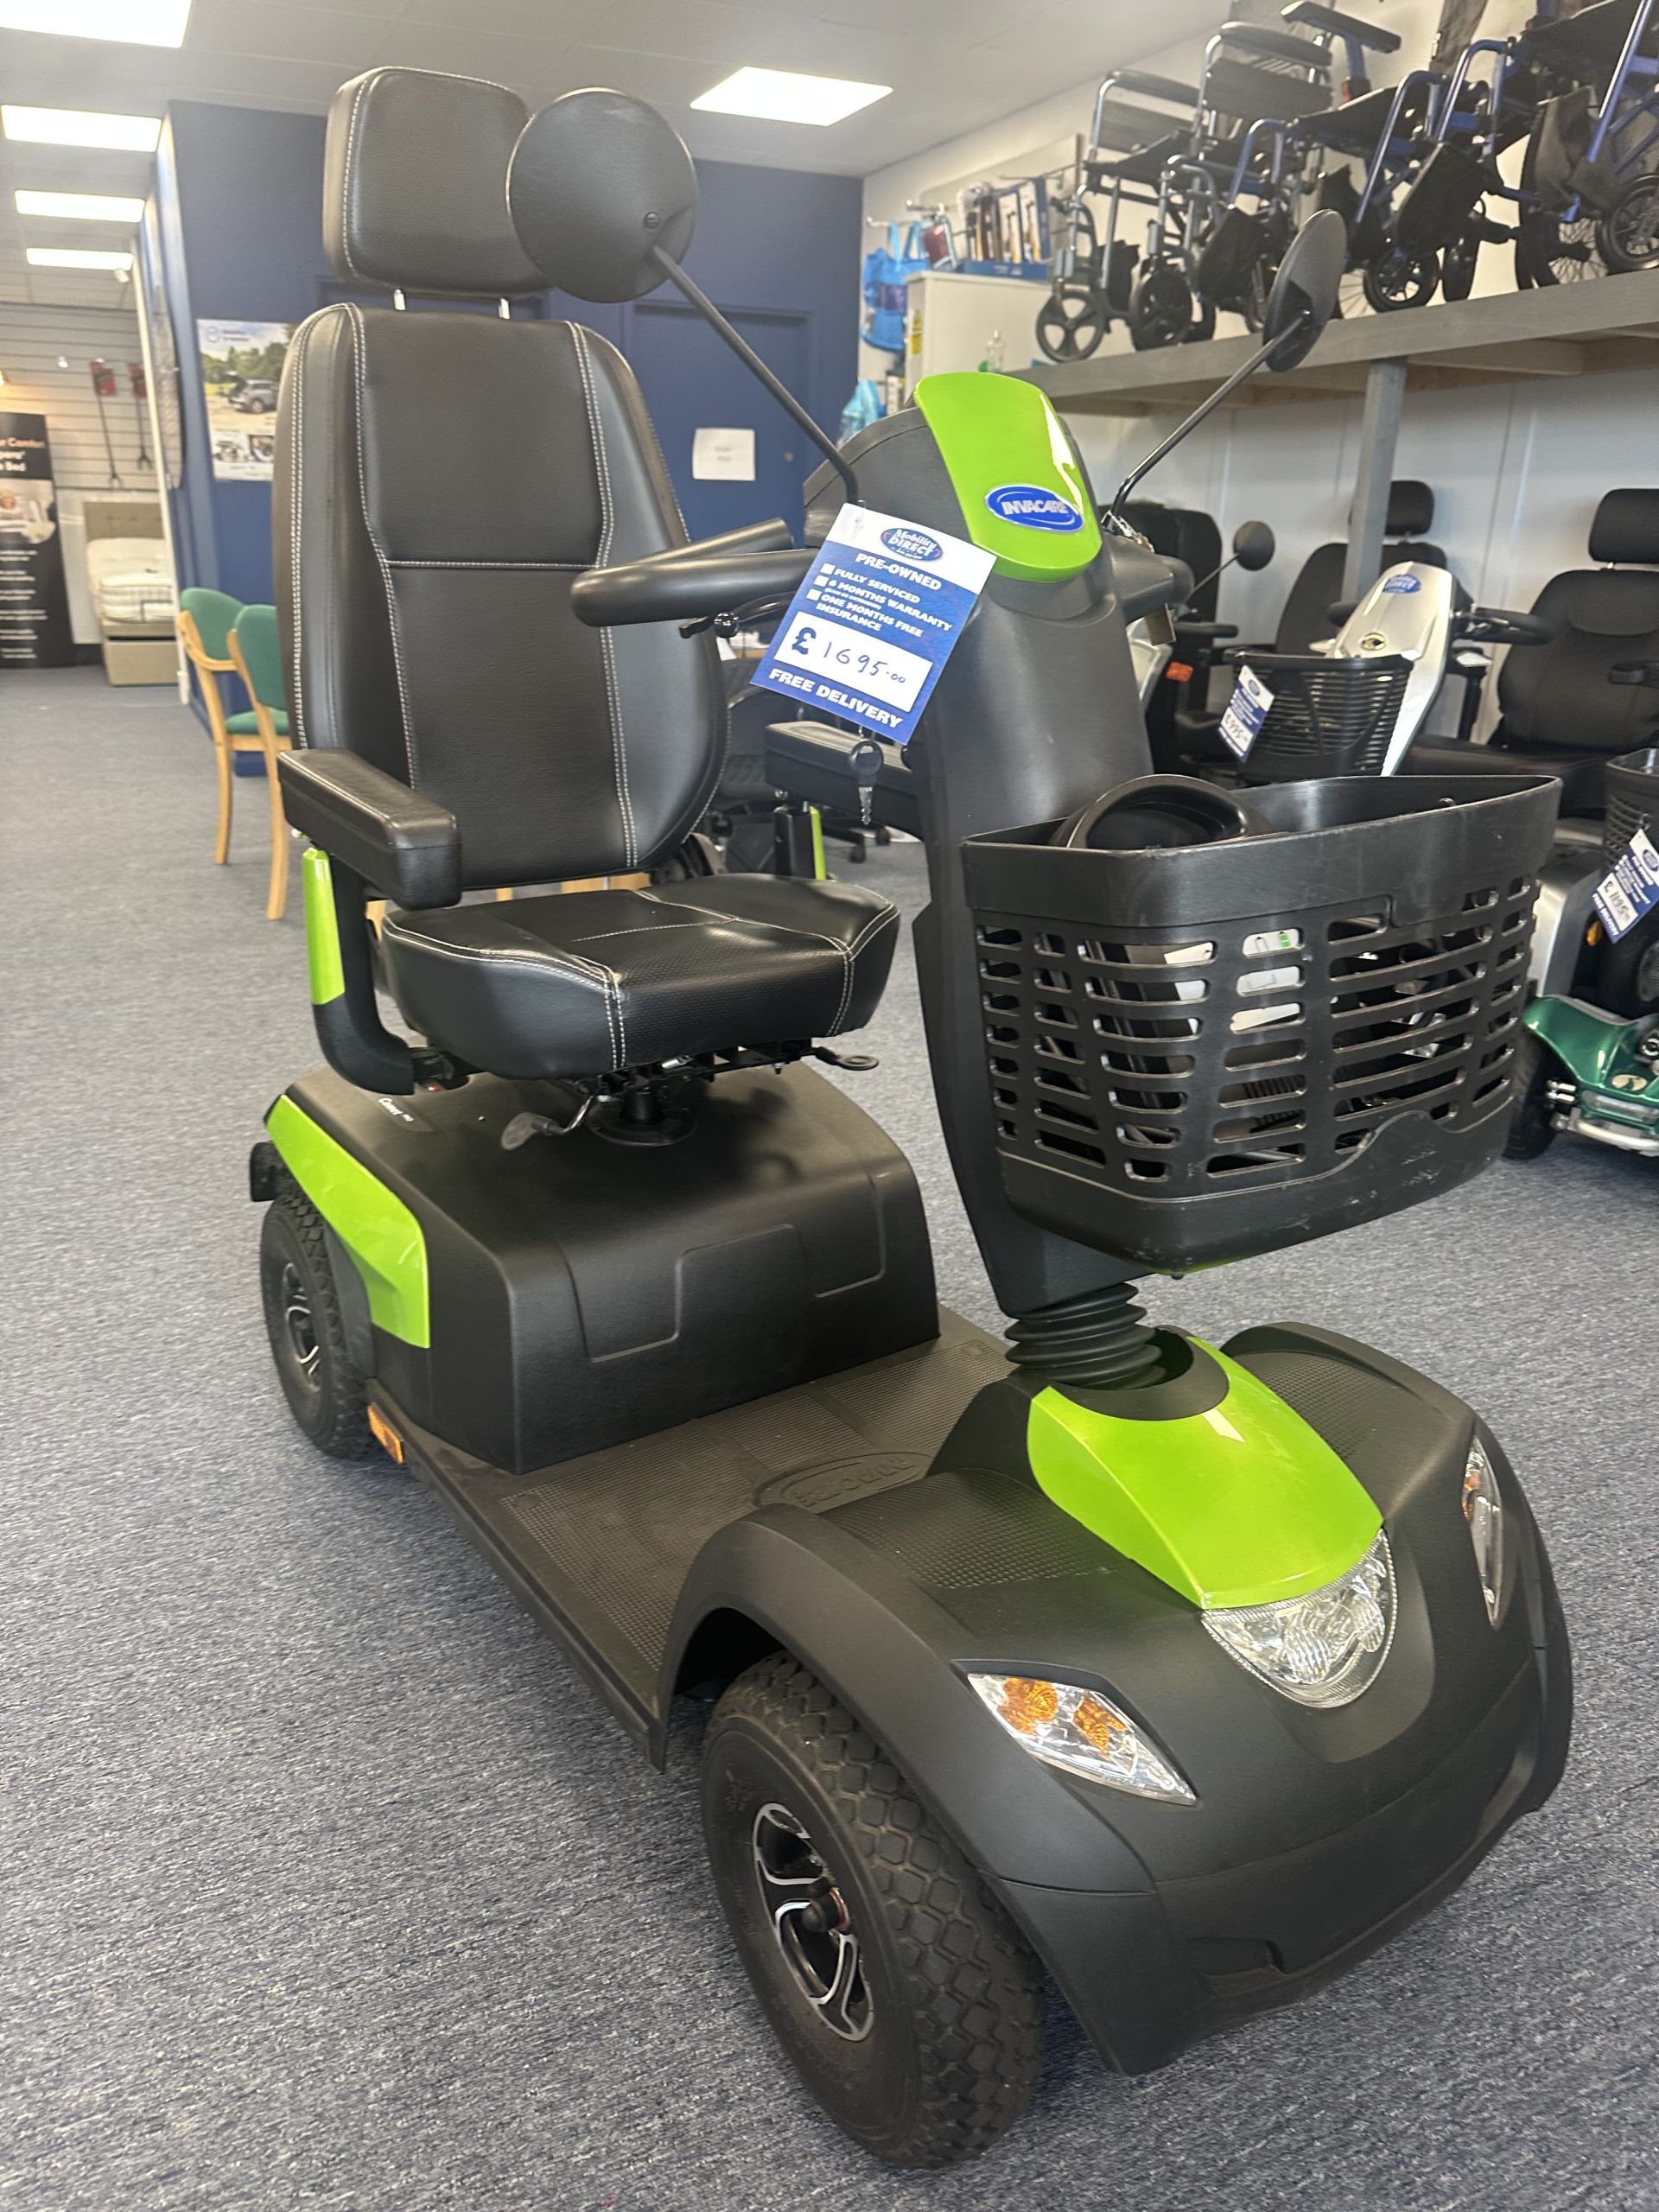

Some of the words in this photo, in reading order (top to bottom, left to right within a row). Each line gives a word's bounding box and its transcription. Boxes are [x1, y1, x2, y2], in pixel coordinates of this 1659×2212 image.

[1001, 499, 1069, 515] INVACARE
[887, 537, 935, 556] DIRECT
[893, 529, 938, 550] Mobility
[834, 569, 868, 584] FULLY
[867, 580, 920, 603] SERVICED
[855, 553, 942, 590] PRE-OWNED
[816, 602, 883, 632] INSURANCE
[821, 594, 846, 607] ONE
[845, 600, 895, 626] MONTHS
[895, 620, 924, 638] FREE
[837, 582, 887, 604] MONTHS
[887, 599, 953, 632] WARRANTY
[768, 668, 816, 693] FREE
[815, 684, 904, 728] DELIVERY
